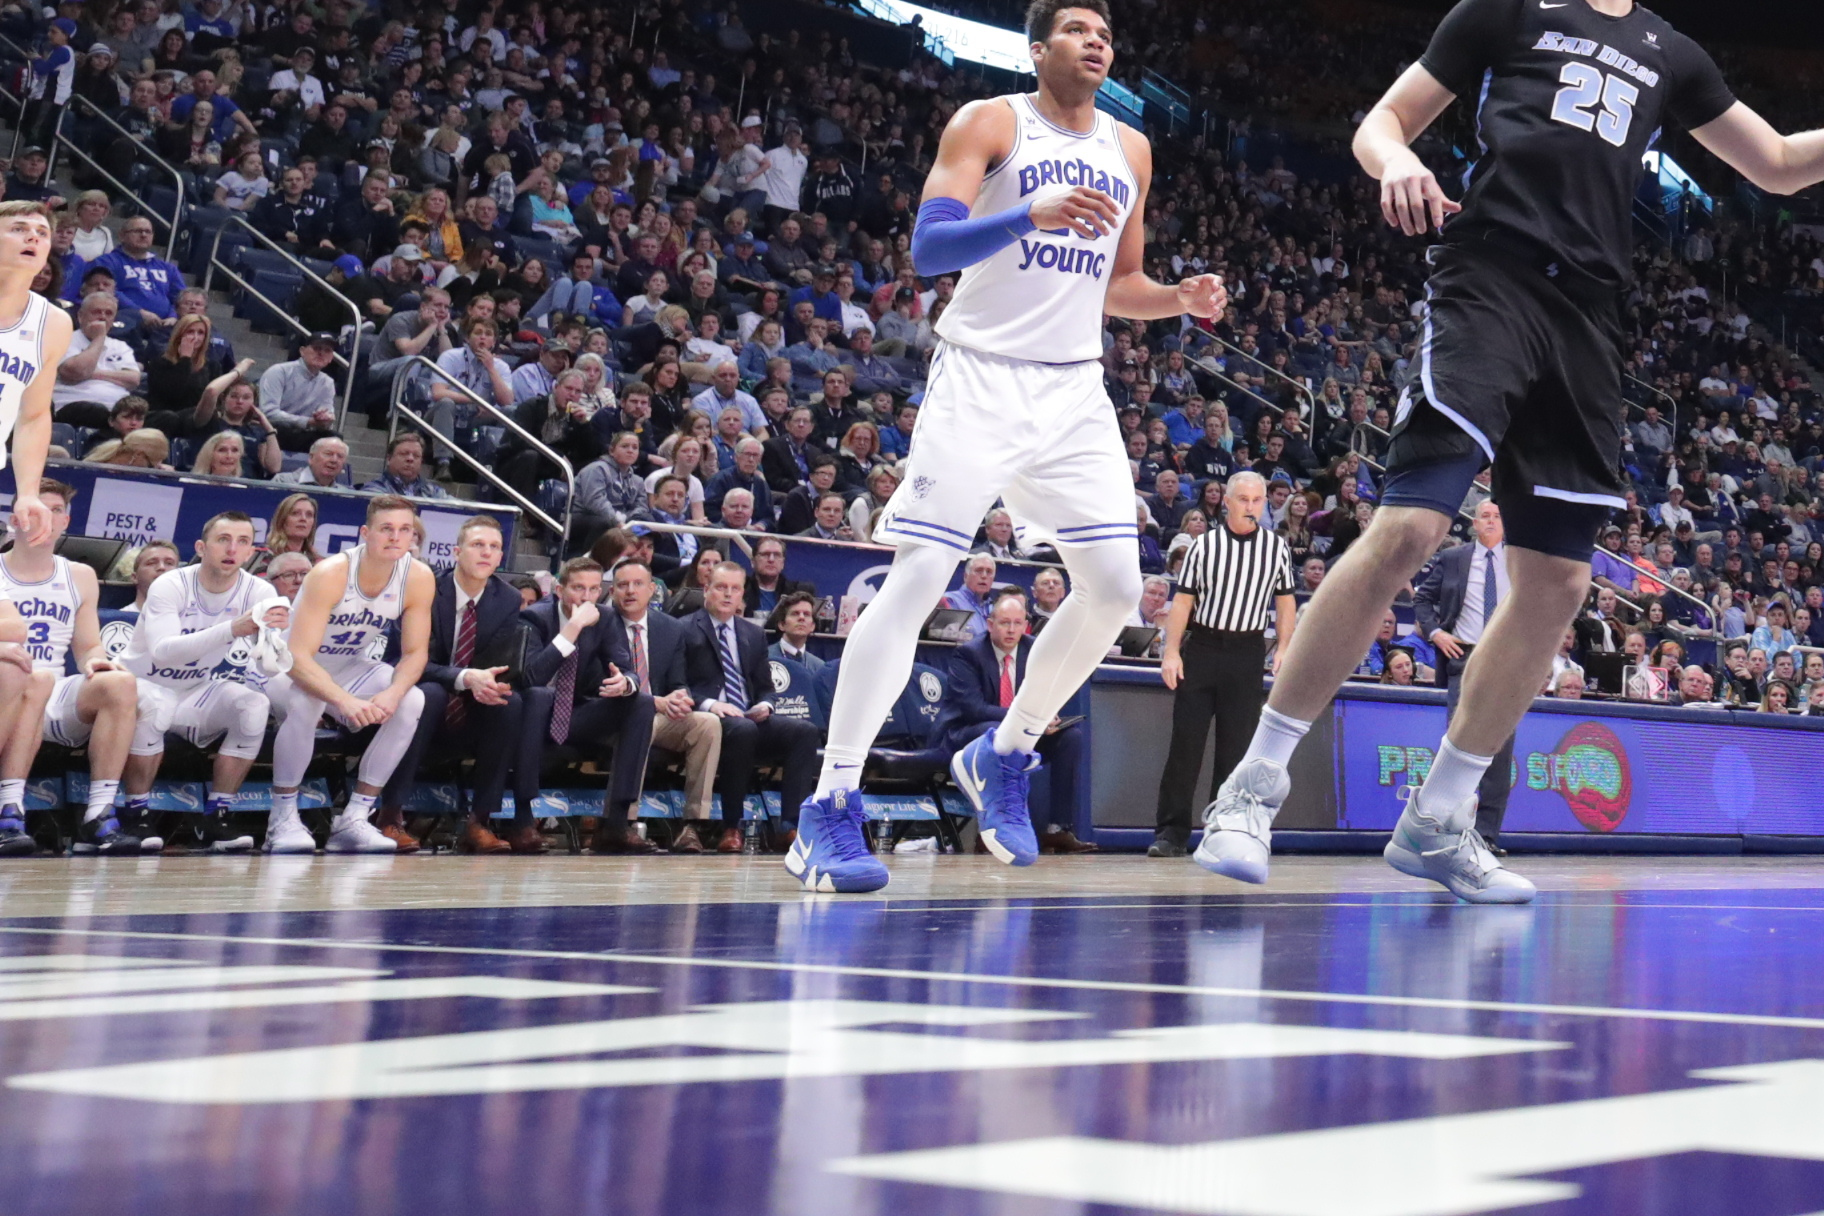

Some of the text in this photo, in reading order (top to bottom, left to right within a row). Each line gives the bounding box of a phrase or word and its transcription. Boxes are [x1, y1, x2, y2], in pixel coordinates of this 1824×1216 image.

[1596, 45, 1659, 87] DIEGO
[1551, 61, 1639, 147] 25
[105, 512, 157, 532] PEST &
[331, 630, 365, 646] 41
